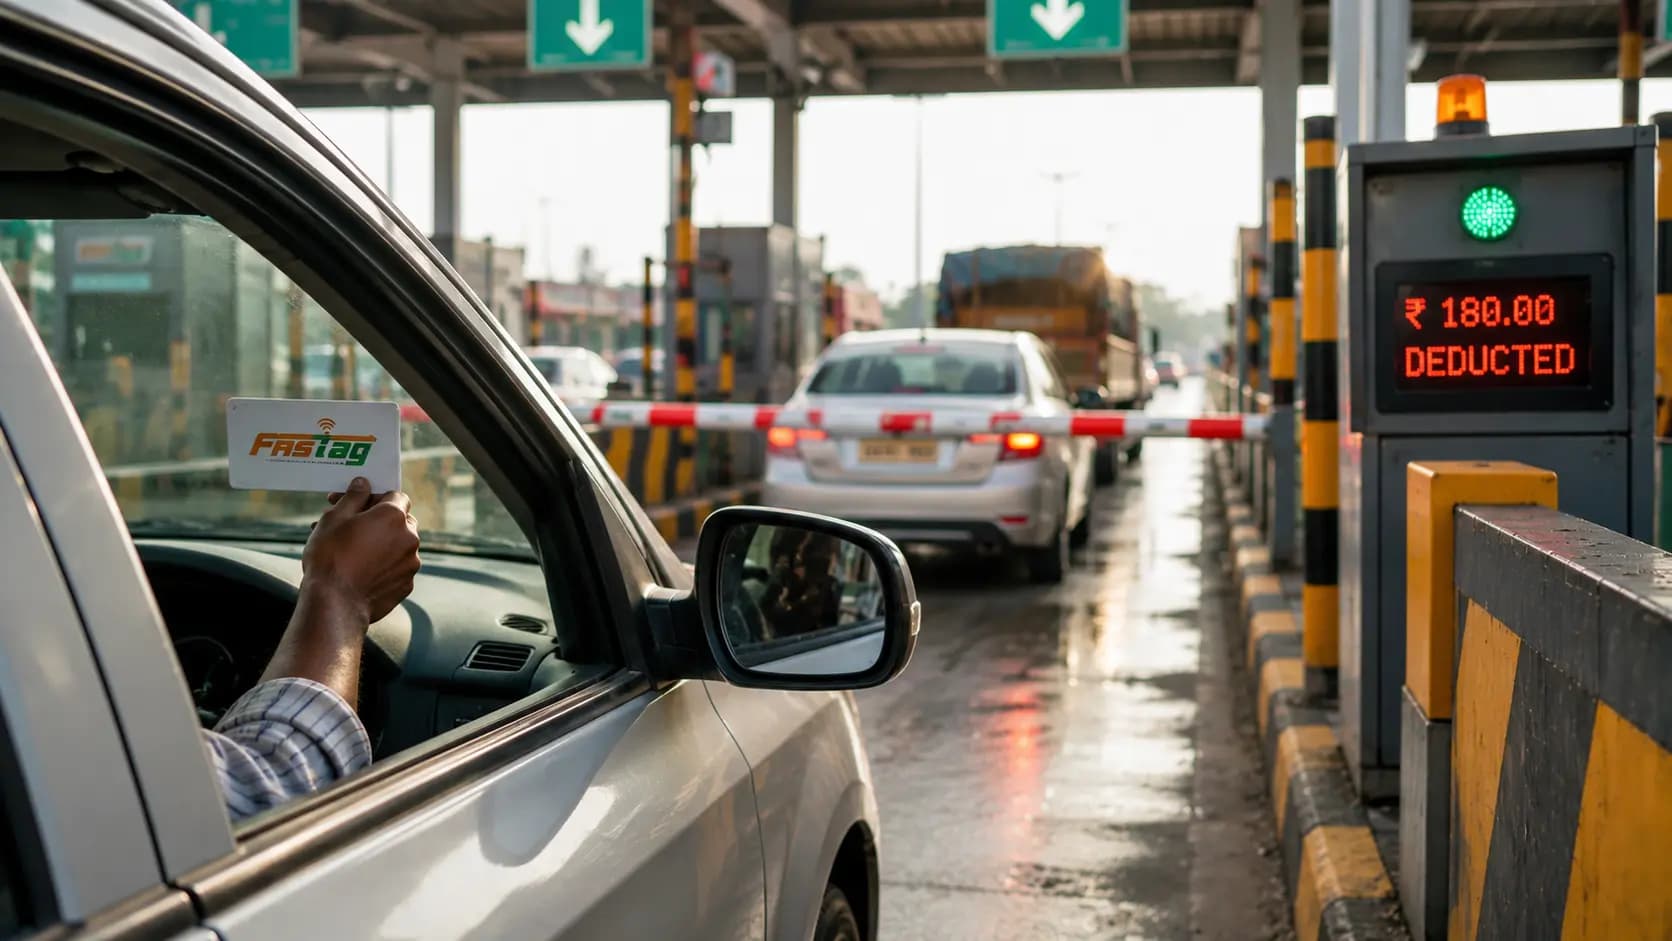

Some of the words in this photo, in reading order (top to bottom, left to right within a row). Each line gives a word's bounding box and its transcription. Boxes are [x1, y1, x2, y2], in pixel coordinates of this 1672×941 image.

[1404, 296, 1427, 330] ₹
[1441, 294, 1555, 329] 180.00
[1404, 343, 1576, 378] DEDUCTED
